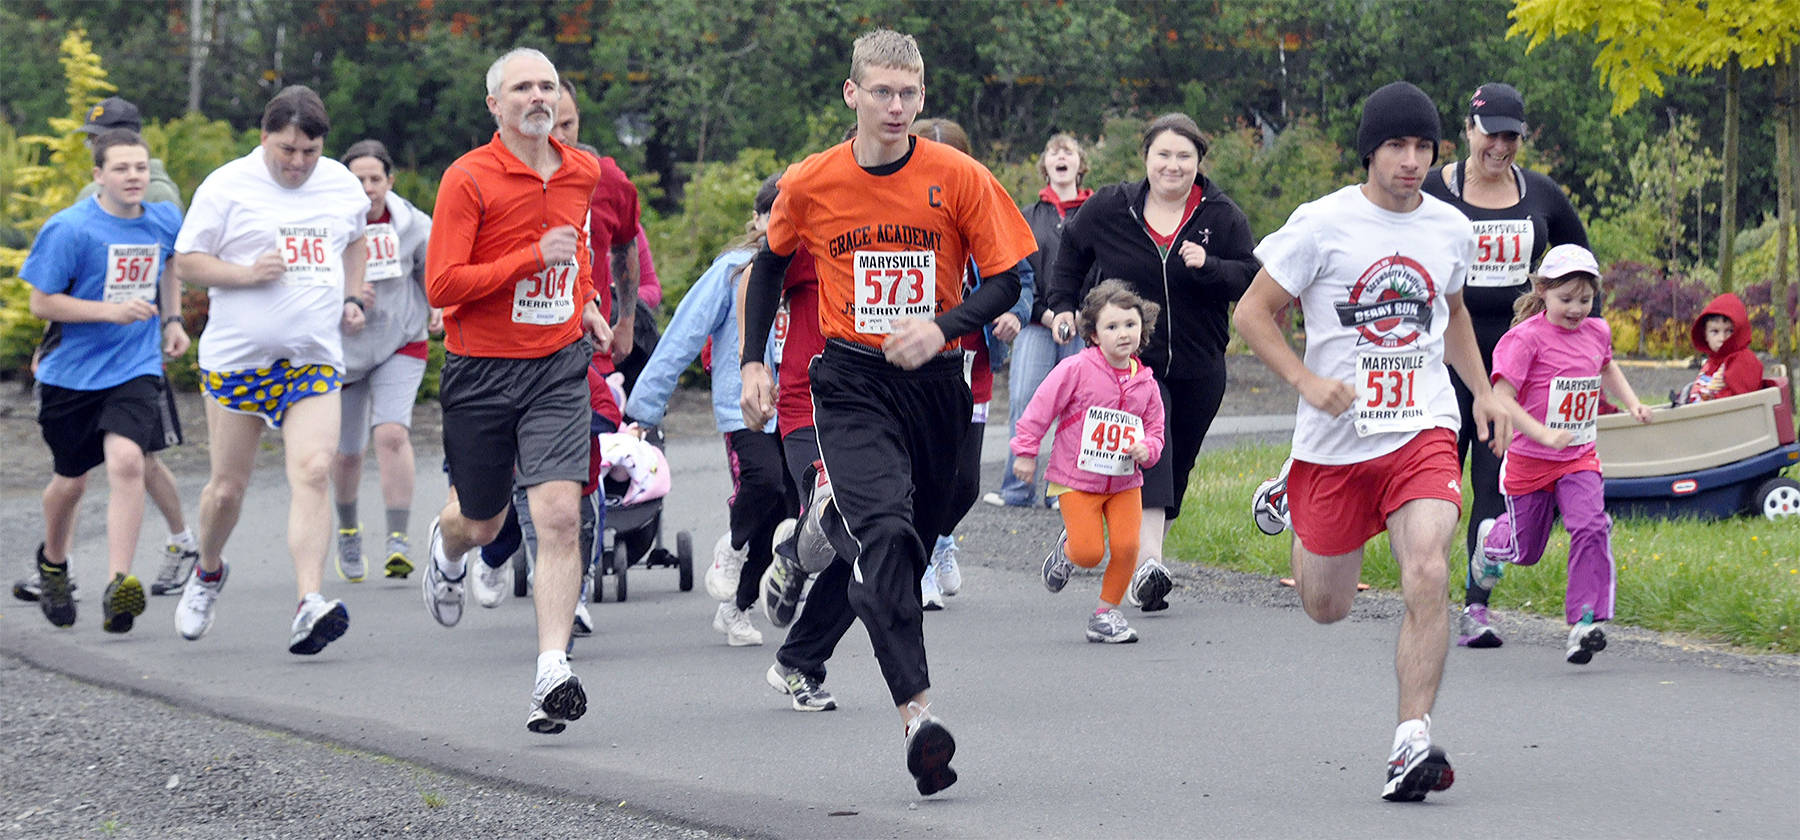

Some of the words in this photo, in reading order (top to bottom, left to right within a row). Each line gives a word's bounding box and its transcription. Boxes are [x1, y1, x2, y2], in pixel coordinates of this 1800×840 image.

[929, 185, 942, 208] C
[286, 236, 325, 265] 546
[828, 225, 872, 258] GRACE
[877, 223, 942, 251] ACADEMY
[1478, 234, 1521, 263] 511
[115, 257, 154, 283] 567
[859, 254, 931, 269] MARYSVILLE
[526, 266, 570, 299] 504
[864, 269, 924, 305] 573
[518, 299, 553, 308] BERRY
[859, 305, 901, 315] BERRY
[905, 304, 930, 314] RUN
[1354, 303, 1393, 322] BERRY
[1394, 301, 1419, 315] RUN
[1361, 355, 1423, 370] MARYSVILLE
[1366, 369, 1415, 408] 531
[1360, 410, 1398, 419] BERRY
[1401, 409, 1423, 418] RUN
[1558, 390, 1598, 422] 487
[1091, 421, 1136, 454] 495
